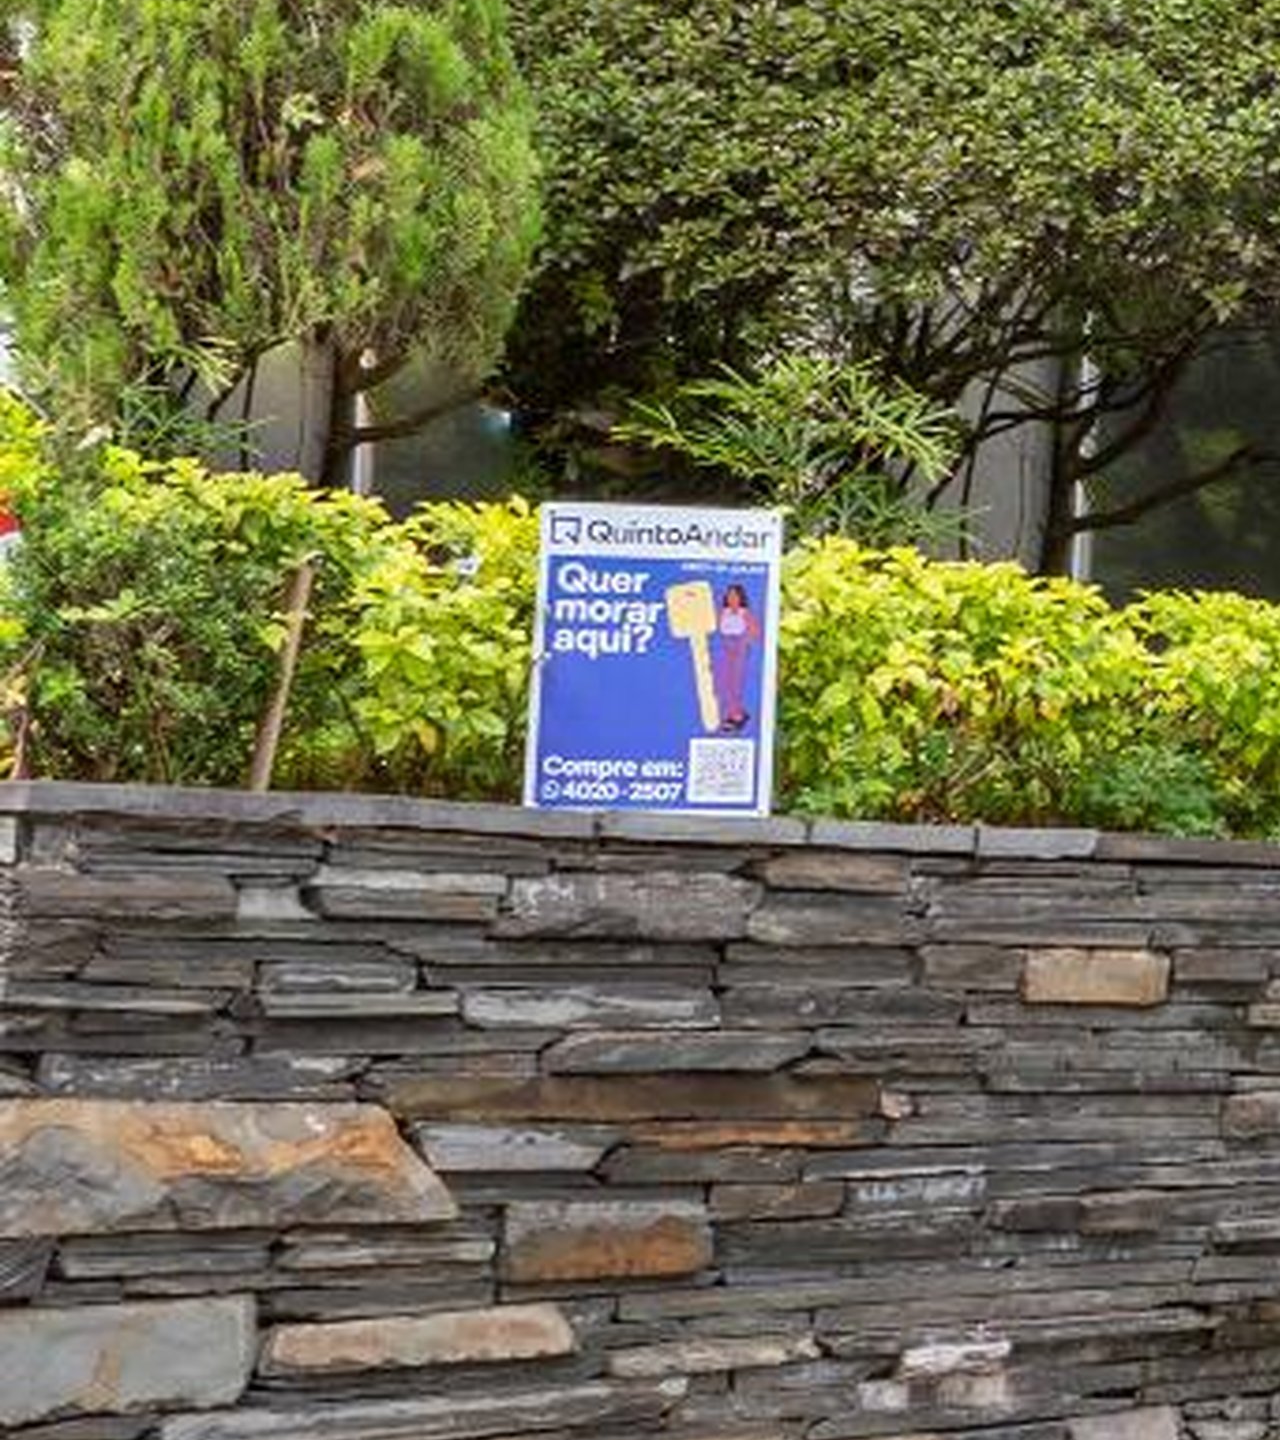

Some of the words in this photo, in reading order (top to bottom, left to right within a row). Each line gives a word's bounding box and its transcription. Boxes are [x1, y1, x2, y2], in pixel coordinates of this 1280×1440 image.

[588, 519, 773, 549] QuintoAndar
[557, 561, 651, 594] Quer
[553, 598, 665, 624] morar
[553, 623, 654, 660] aqui?
[542, 755, 638, 780] Compre
[640, 759, 684, 778] em:
